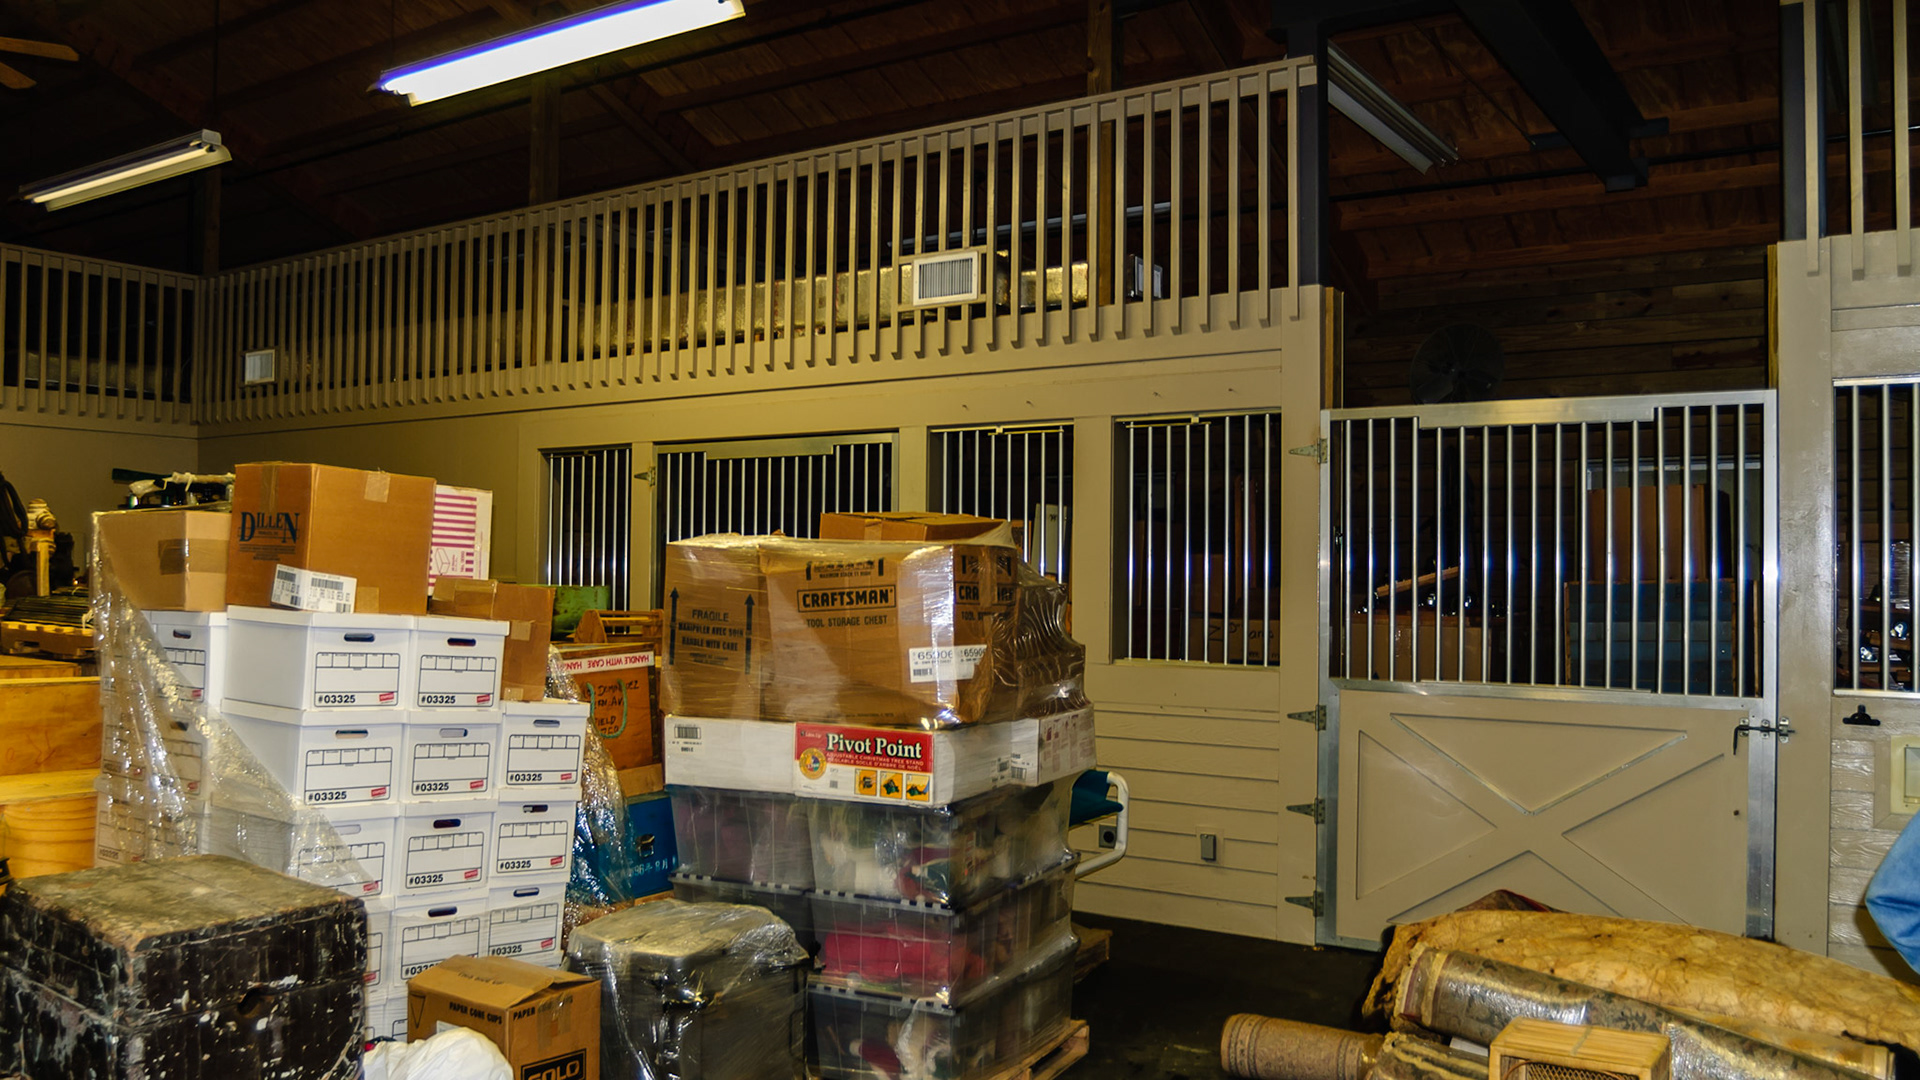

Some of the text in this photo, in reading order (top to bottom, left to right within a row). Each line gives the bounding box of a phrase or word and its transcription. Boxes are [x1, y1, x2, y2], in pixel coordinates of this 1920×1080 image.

[240, 511, 300, 544] DILLEN
[802, 589, 889, 608] CRAFTSMAN
[692, 609, 729, 622] FRAGILE
[806, 614, 887, 628] TOOL STORAGE CHEST
[587, 659, 605, 669] CARE
[606, 657, 624, 667] WITH
[318, 694, 356, 704] #03325
[421, 695, 456, 705] #03325
[826, 732, 922, 759] Pivot Point
[859, 754, 889, 763] CHRISTMAS
[891, 757, 904, 765] TREE
[905, 759, 924, 767] STAND
[509, 773, 543, 783] #03325
[415, 782, 450, 792] #03325
[308, 790, 348, 802] #03325
[500, 859, 532, 870] #03325
[409, 873, 444, 885] #03325
[491, 944, 523, 956] #03325
[449, 1001, 502, 1025] PAPER CONE CUPS
[513, 1006, 536, 1021] PAPER
